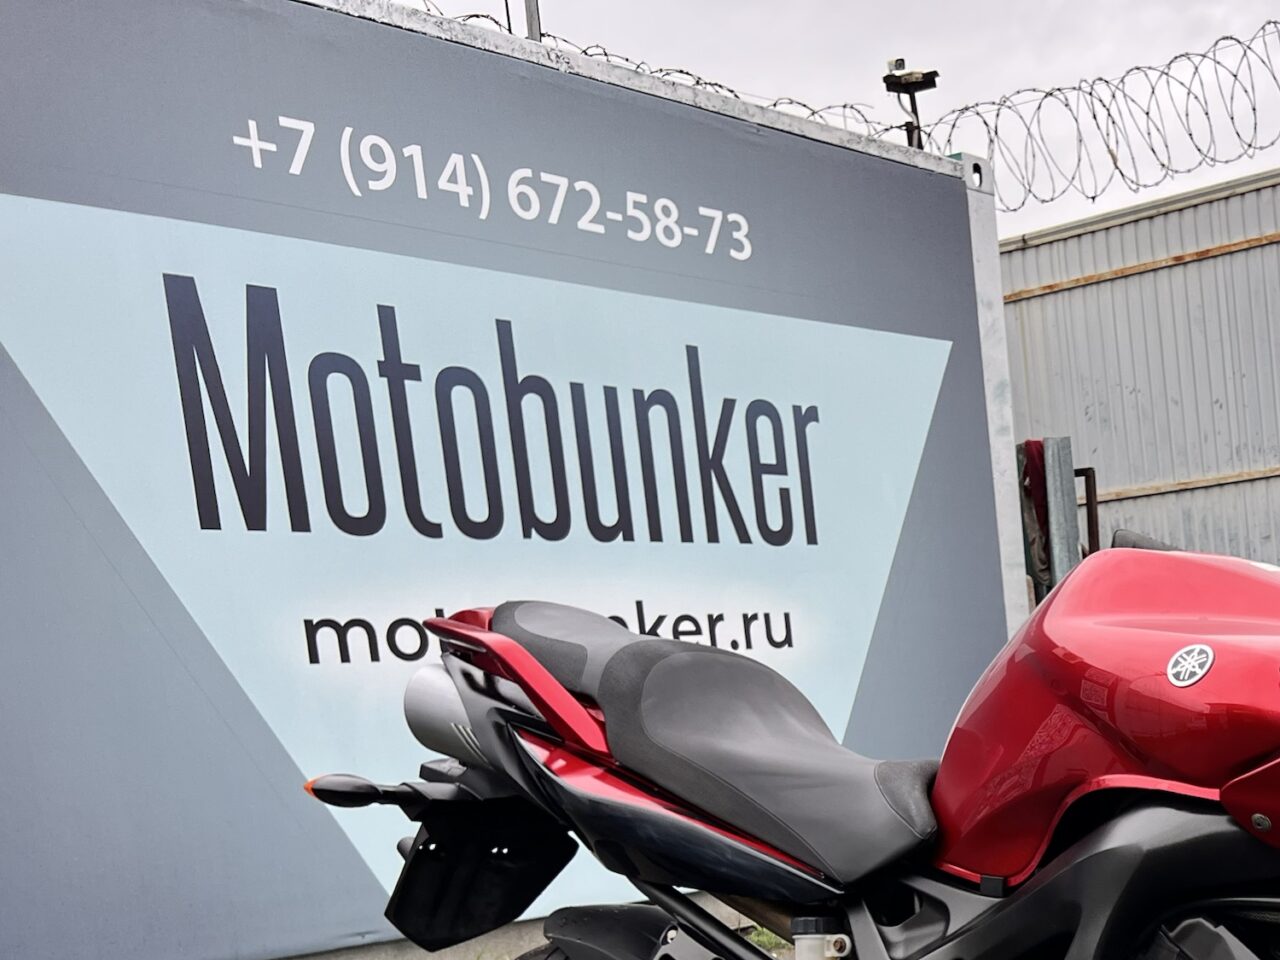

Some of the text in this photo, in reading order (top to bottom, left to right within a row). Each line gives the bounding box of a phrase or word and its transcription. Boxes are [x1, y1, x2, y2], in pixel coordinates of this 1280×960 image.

[232, 115, 754, 262] +7 (914) 672-58-73
[162, 272, 820, 548] Motobunker
[303, 599, 795, 665] moker.ru
